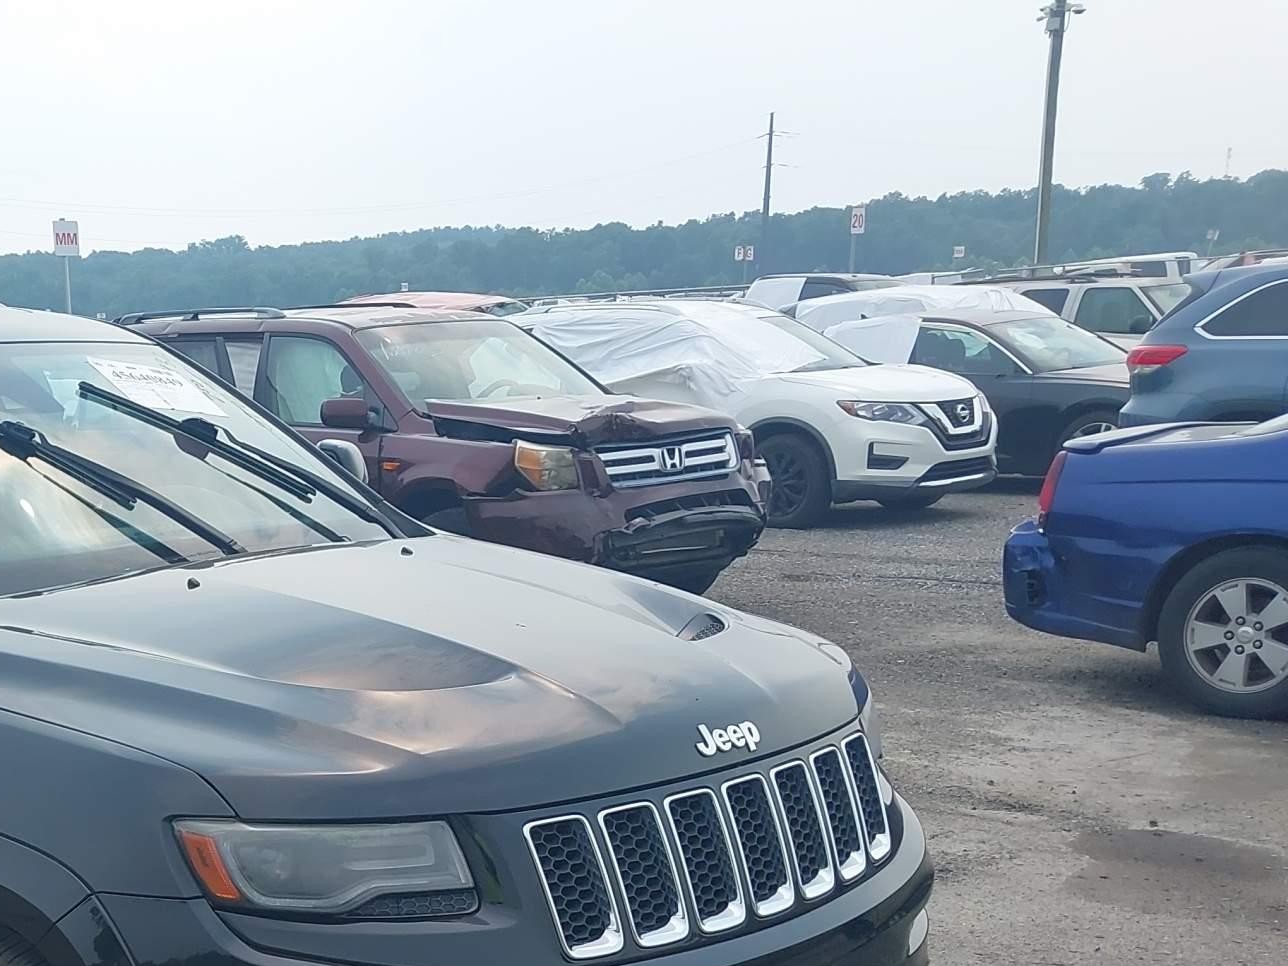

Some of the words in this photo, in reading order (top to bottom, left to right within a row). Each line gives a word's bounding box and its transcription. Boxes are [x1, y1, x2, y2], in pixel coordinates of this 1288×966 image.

[852, 213, 864, 229] 20
[55, 232, 78, 246] MM
[696, 720, 761, 756] Jeep
